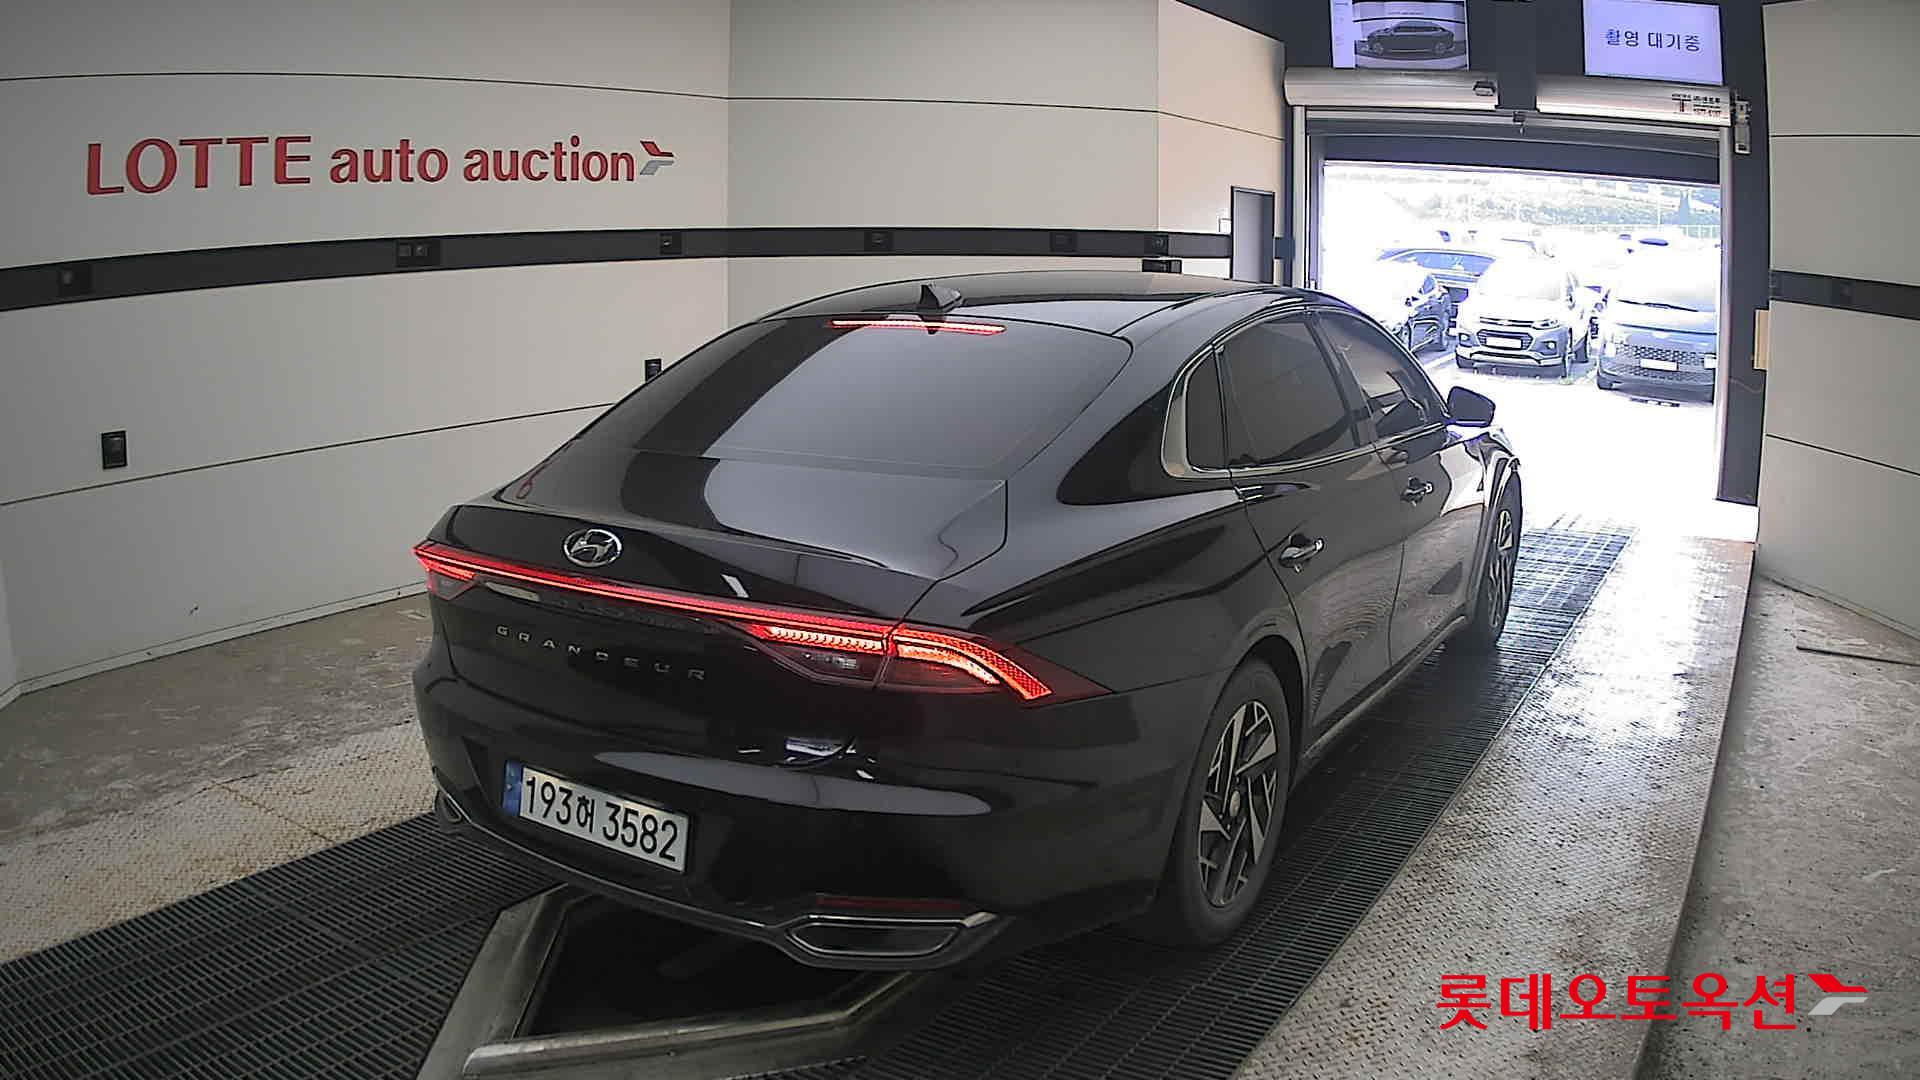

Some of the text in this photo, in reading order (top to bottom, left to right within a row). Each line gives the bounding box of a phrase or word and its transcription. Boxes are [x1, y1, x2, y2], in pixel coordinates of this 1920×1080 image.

[1648, 31, 1700, 52] 대기중
[87, 136, 634, 195] LOTTE auto auction
[496, 625, 705, 681] GRANDEUR
[526, 776, 677, 862] 193허 3582
